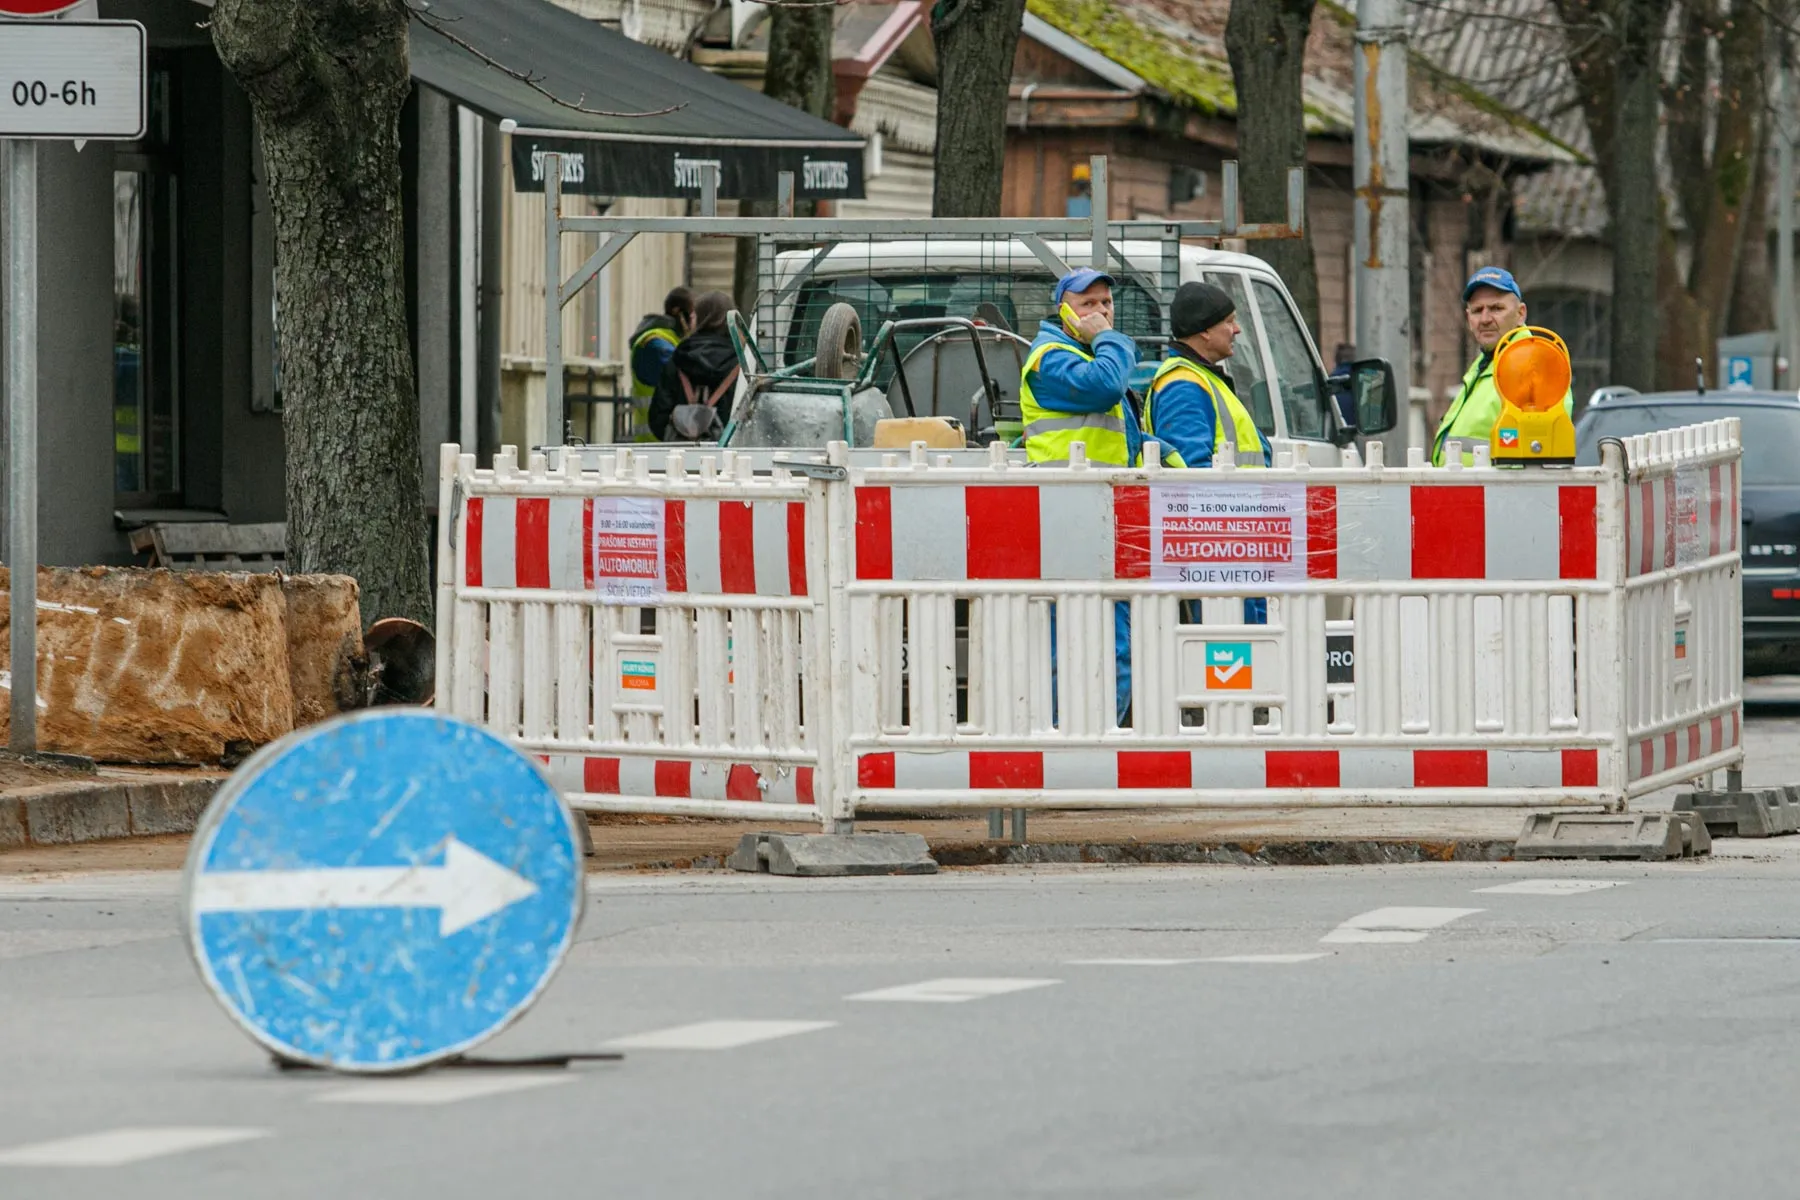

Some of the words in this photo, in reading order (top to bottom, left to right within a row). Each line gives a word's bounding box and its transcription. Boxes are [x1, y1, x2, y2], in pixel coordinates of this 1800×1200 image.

[12, 80, 96, 106] 00-6h
[1167, 503, 1189, 513] 9:00
[1200, 503, 1227, 513] 16:00
[1229, 503, 1286, 513] valandomis
[1163, 519, 1223, 532] PRAŠOME
[1226, 521, 1291, 532] NESTATYTI
[1163, 542, 1291, 561] AUTOMOBILIŲ
[1179, 567, 1216, 582] ŠIOJE
[1220, 570, 1276, 582] VIETOJE
